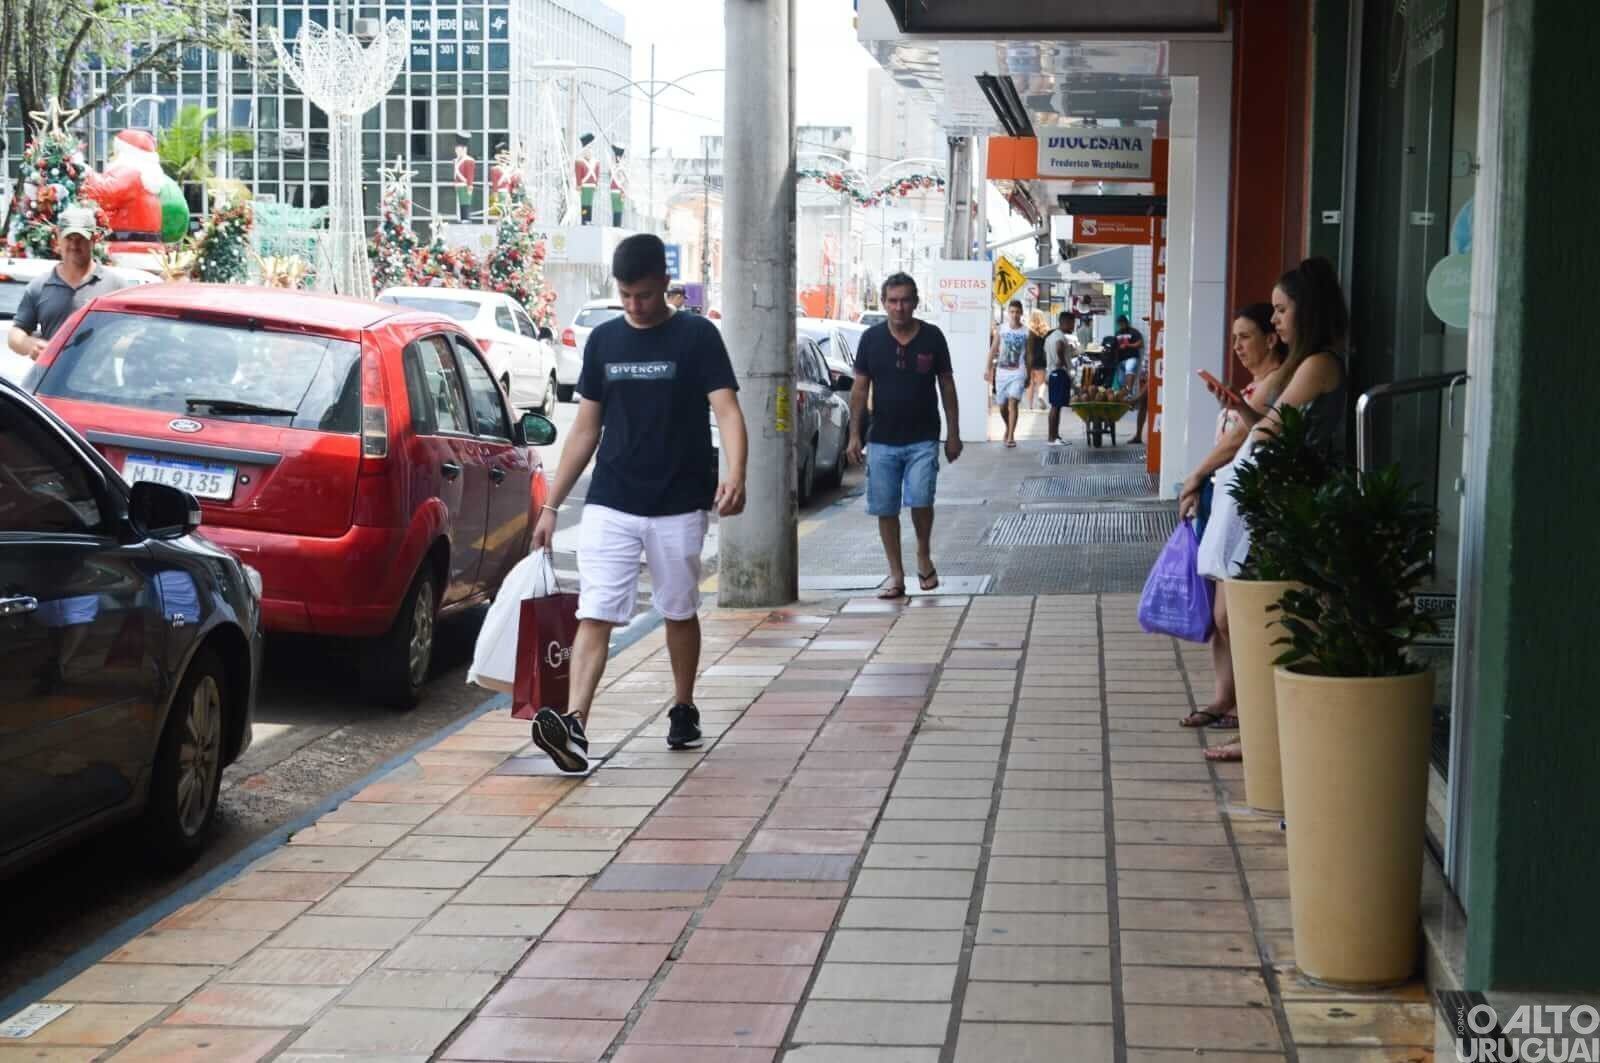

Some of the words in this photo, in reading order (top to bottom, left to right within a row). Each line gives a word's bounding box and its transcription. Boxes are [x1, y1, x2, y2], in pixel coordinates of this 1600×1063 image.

[440, 45, 454, 54] 301
[1048, 135, 1143, 151] DIOCESANA
[1050, 158, 1089, 168] Frederico
[939, 279, 986, 289] OFERTAS
[610, 364, 668, 374] GIVENCHY
